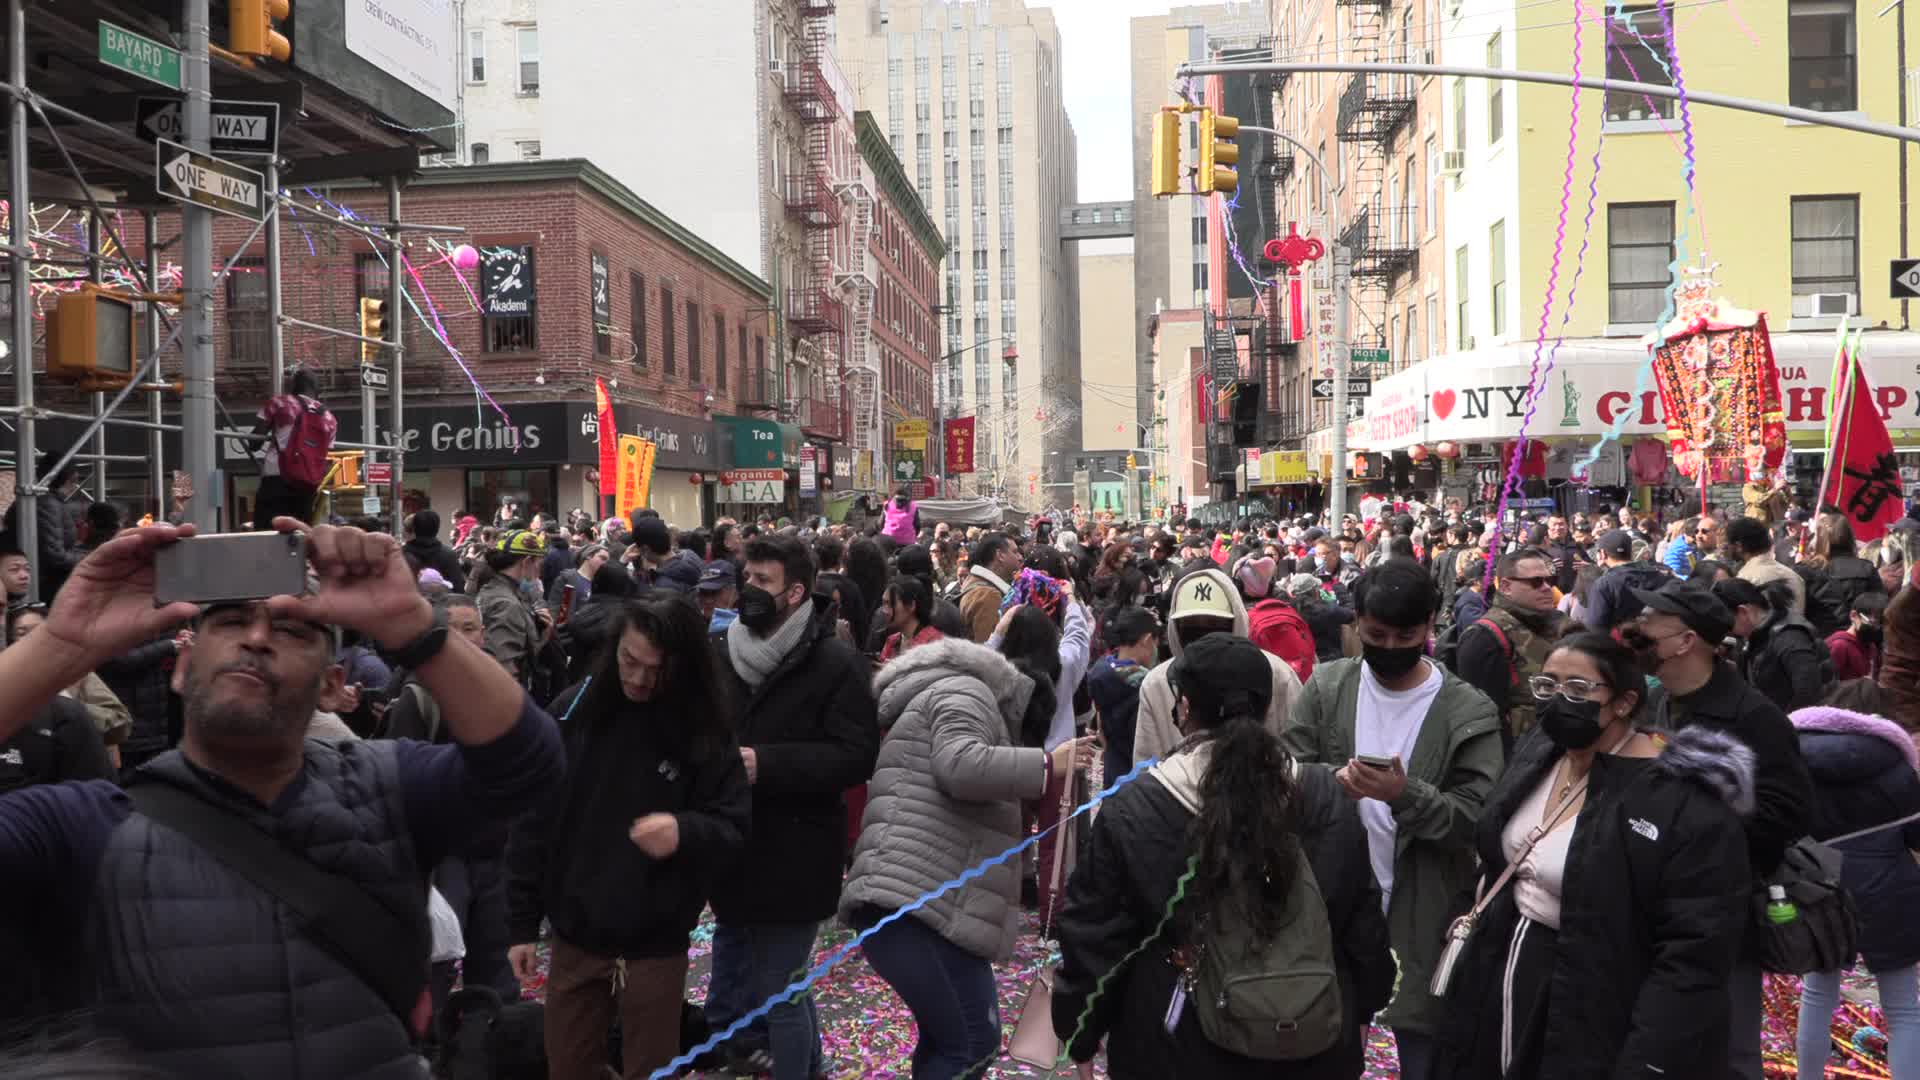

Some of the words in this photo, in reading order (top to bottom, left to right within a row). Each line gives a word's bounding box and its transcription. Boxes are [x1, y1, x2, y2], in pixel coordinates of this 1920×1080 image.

[106, 29, 162, 66] BAYARD
[216, 117, 258, 137] WAY
[176, 163, 206, 189] ONE
[221, 176, 251, 202] WAY
[490, 299, 527, 312] Akademi
[1354, 350, 1378, 358] Mott
[1462, 385, 1530, 420] NY
[1393, 405, 1416, 438] SHOP
[431, 419, 541, 452] Genius
[752, 429, 774, 440] Tea
[725, 471, 774, 480] Organic
[722, 481, 778, 501] TEA
